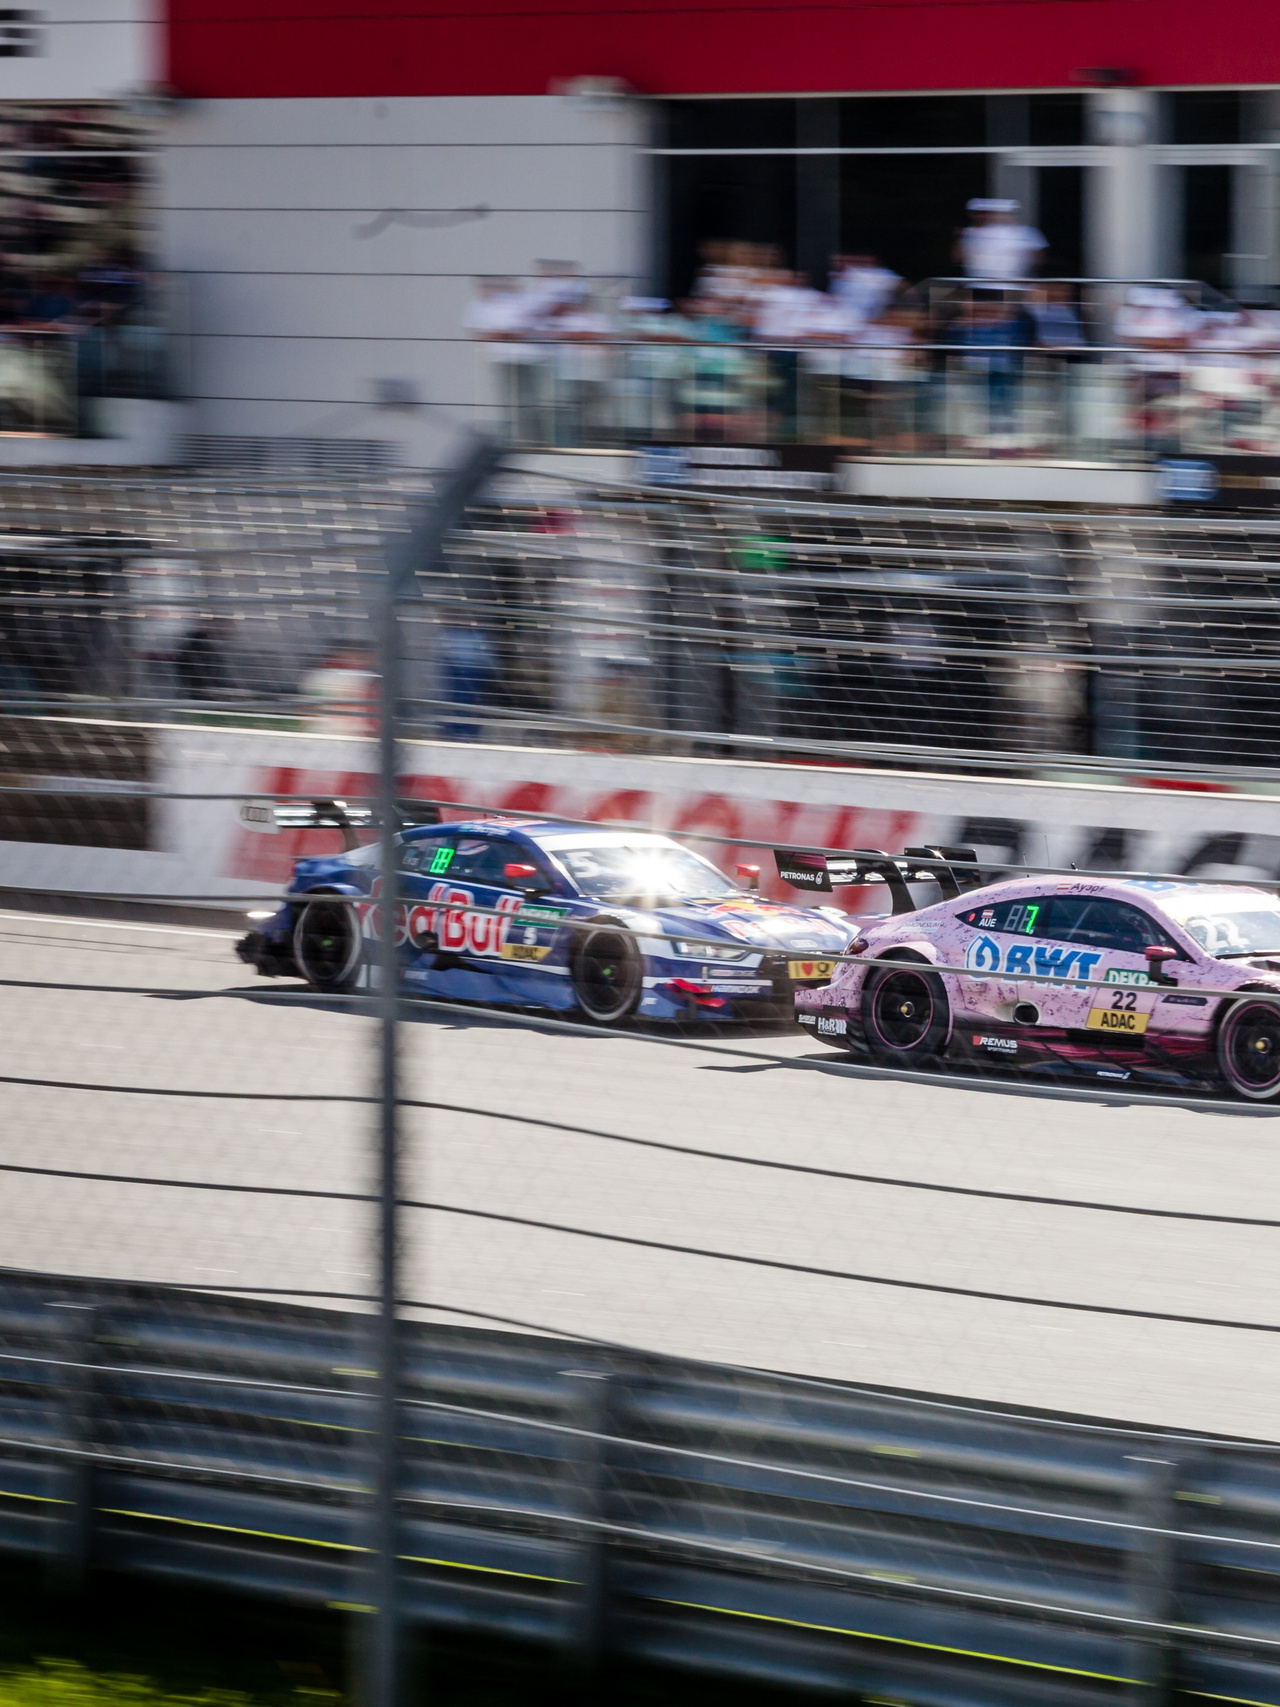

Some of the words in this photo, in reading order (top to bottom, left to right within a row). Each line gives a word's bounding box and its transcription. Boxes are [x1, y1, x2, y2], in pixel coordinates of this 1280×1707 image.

[566, 851, 599, 878] 5
[780, 871, 815, 881] PETRONAS
[439, 887, 525, 956] Bull
[979, 918, 996, 927] AUE
[1024, 905, 1039, 933] 7
[523, 928, 538, 945] 5
[1186, 915, 1250, 949] 22
[1004, 945, 1104, 991] BWT
[1108, 970, 1158, 986] DEKR
[1111, 990, 1137, 1011] 22
[818, 1017, 836, 1031] H&R
[1101, 1012, 1135, 1030] ADAC
[979, 1036, 1018, 1049] REMUS
